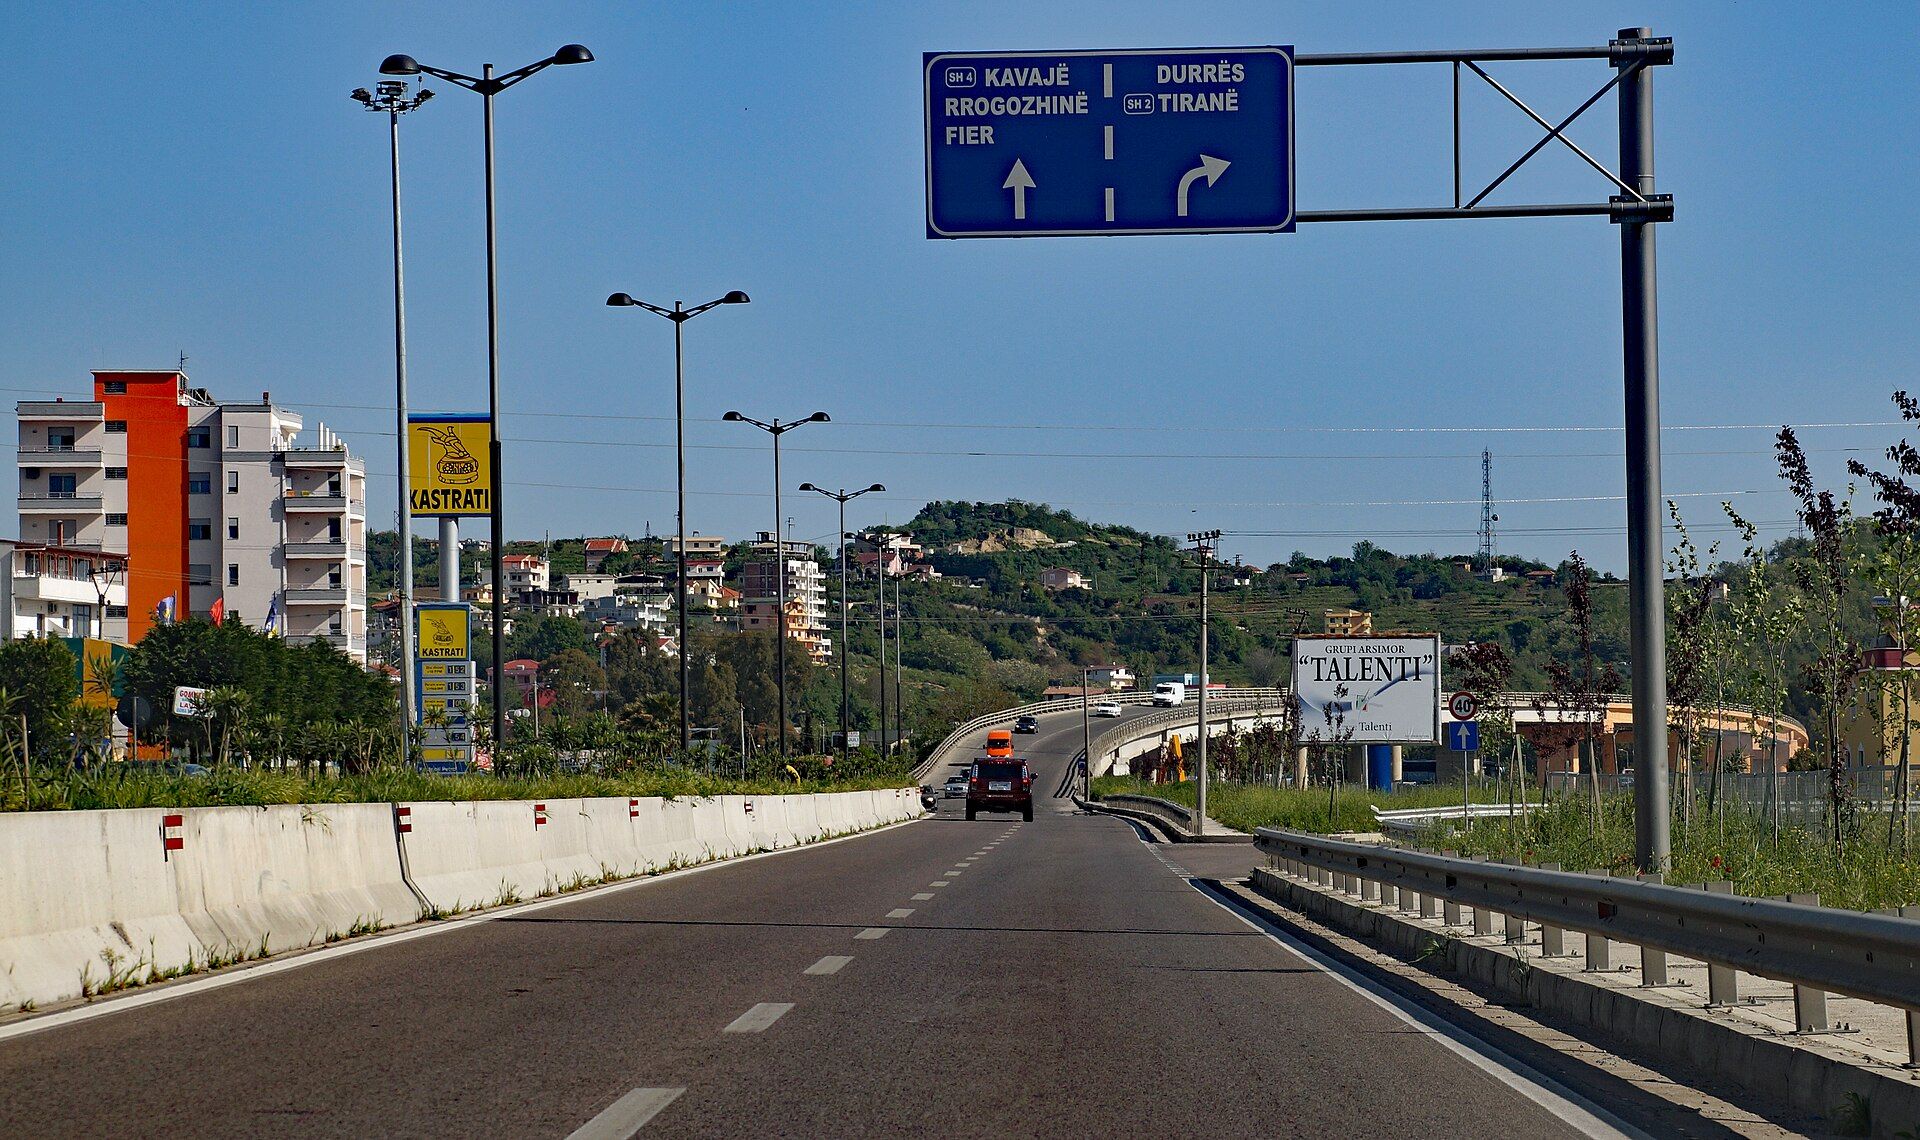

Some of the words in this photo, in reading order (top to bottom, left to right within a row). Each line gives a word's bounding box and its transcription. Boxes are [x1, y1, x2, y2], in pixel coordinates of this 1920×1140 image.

[949, 73, 963, 82] SH
[966, 73, 973, 82] 4
[985, 63, 1069, 87] KAVAJË
[1157, 60, 1245, 83] DURRËS
[945, 91, 1089, 116] RROGOZHINË
[1127, 99, 1142, 110] SH
[1144, 99, 1151, 109] 2
[1157, 89, 1239, 112] TIRANË
[945, 126, 995, 145] FIER
[410, 488, 489, 510] KASTRATI
[422, 648, 464, 657] KASTRATI
[1325, 645, 1356, 654] GRUPI
[1358, 645, 1406, 654] ARSIMOR
[1299, 654, 1433, 682] “TALENTI”
[1455, 699, 1471, 712] 40
[1359, 721, 1393, 731] Talenti
